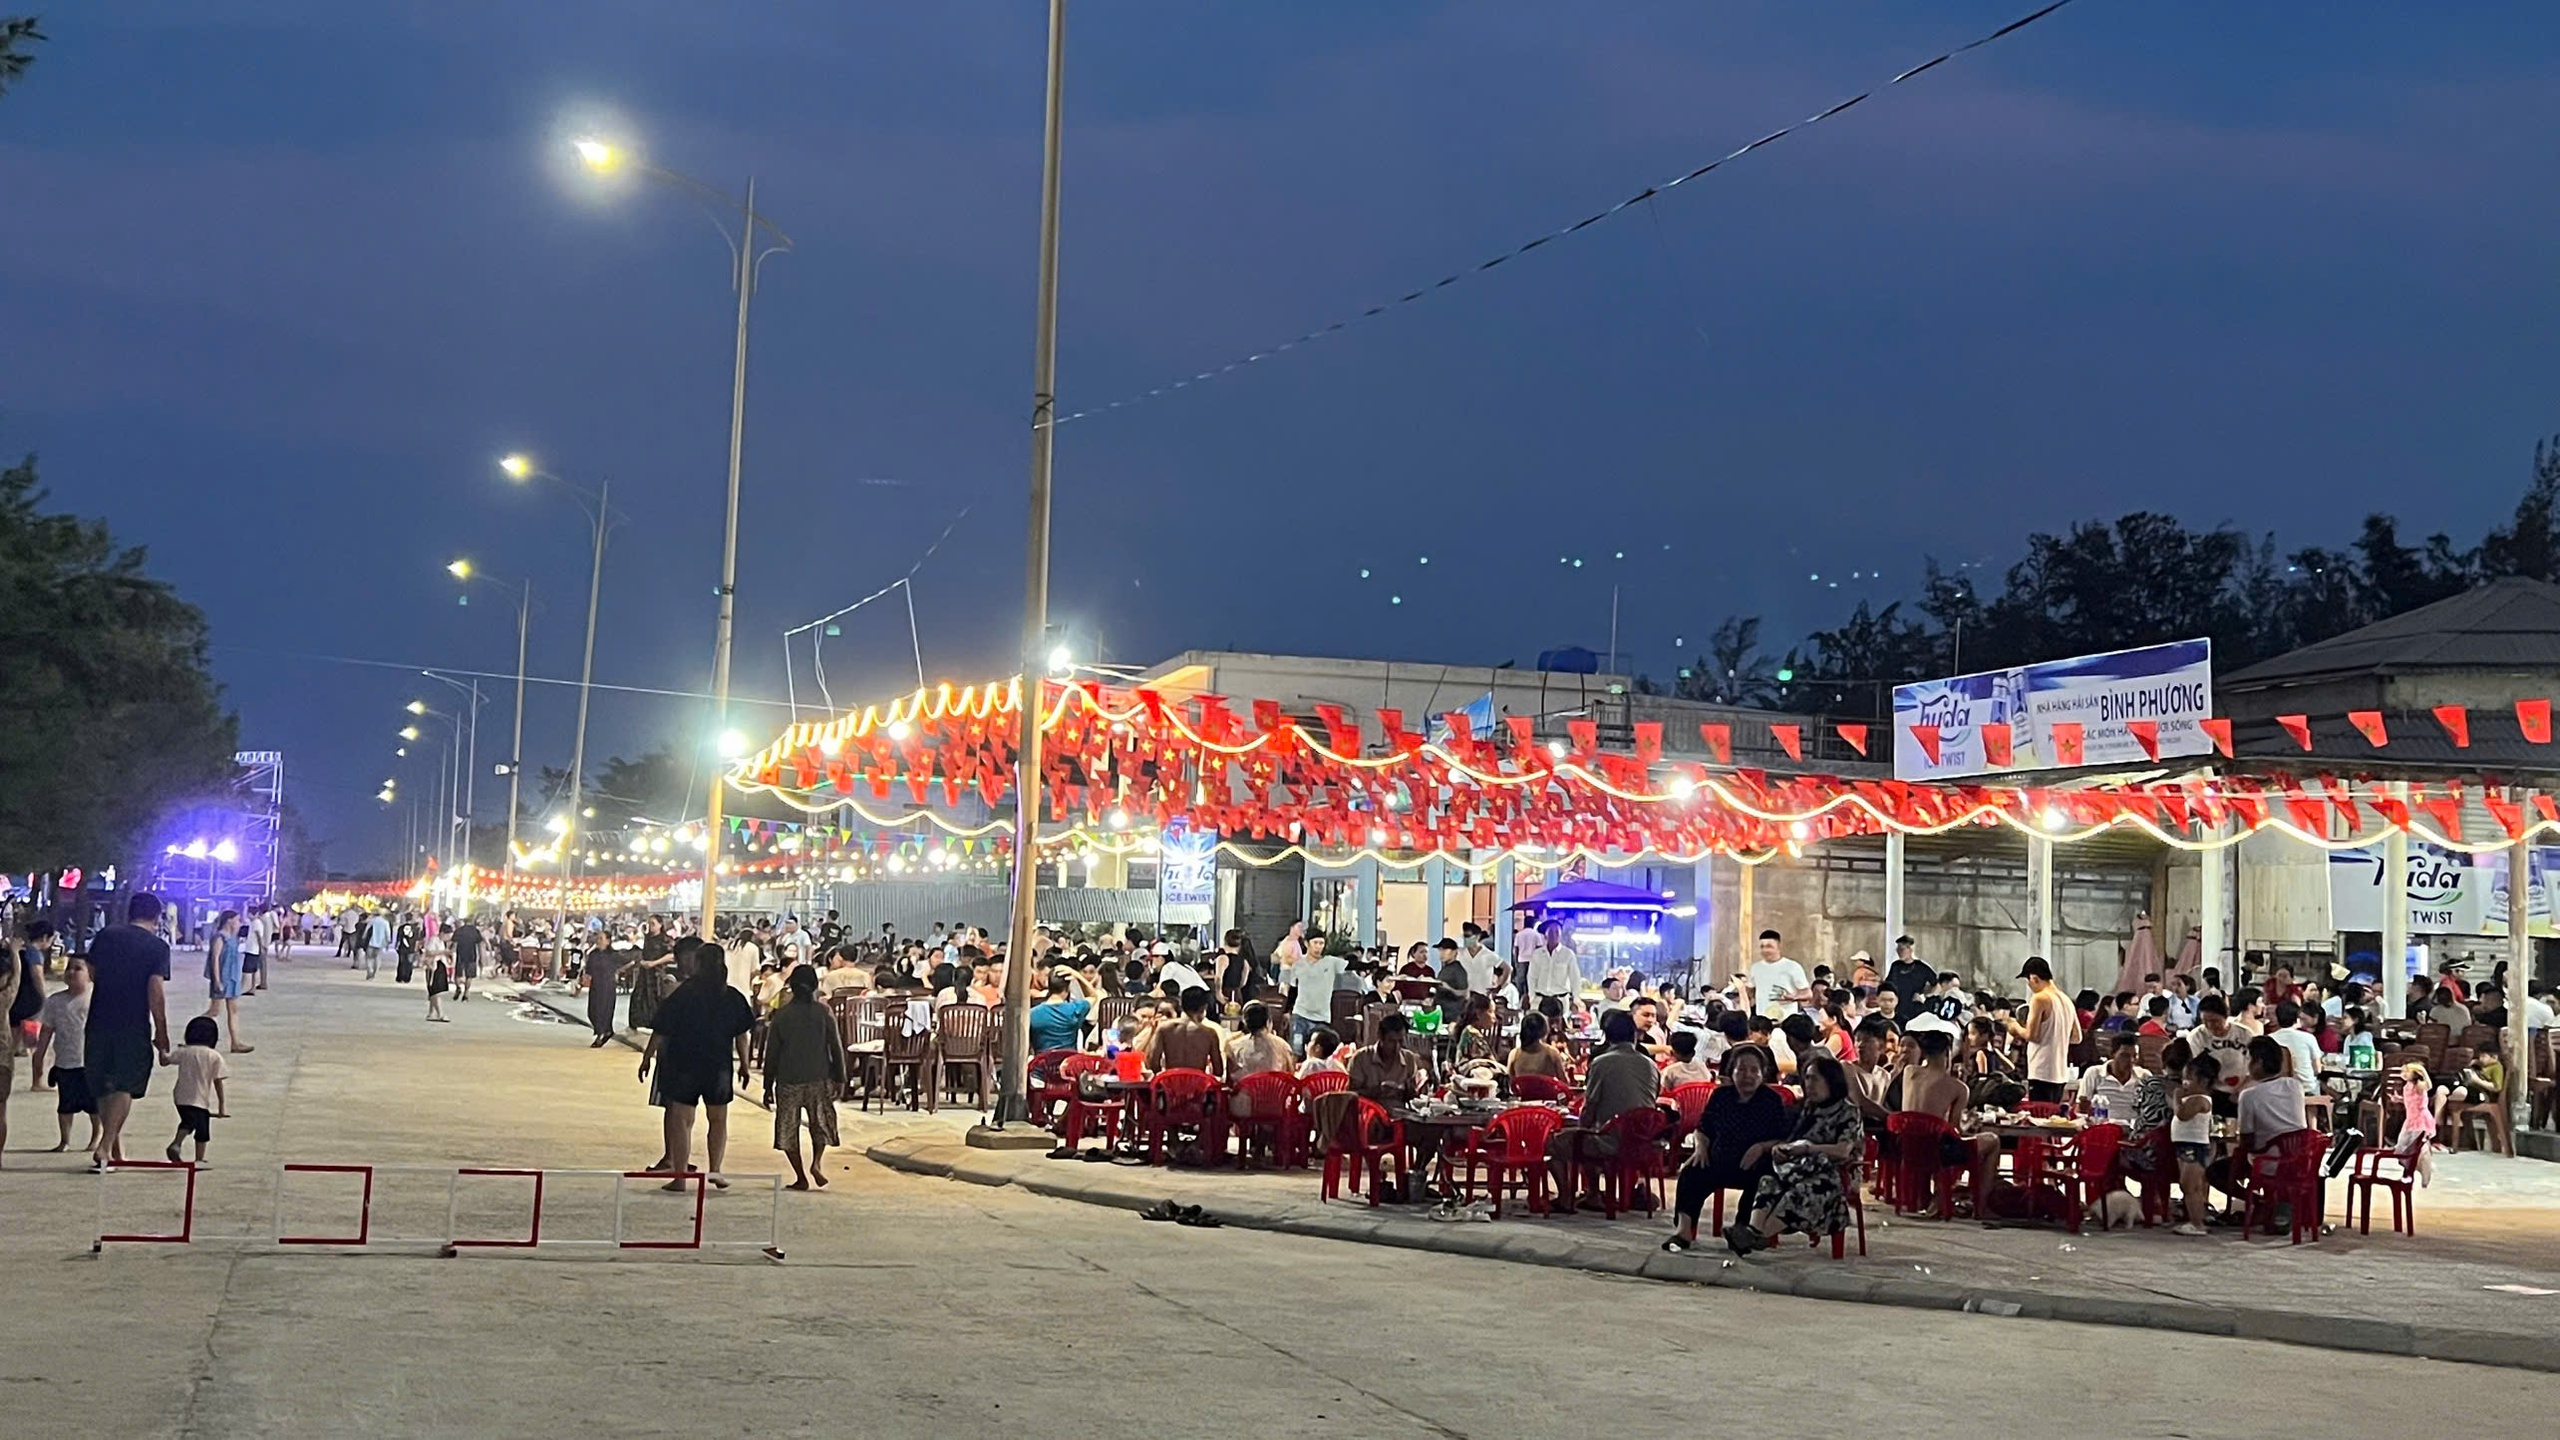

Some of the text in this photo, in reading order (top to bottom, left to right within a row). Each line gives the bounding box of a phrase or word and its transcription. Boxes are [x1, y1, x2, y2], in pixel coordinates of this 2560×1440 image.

[2101, 688, 2135, 721] BÌNH
[2139, 683, 2204, 717] PHƯƠNG
[1940, 750, 1965, 767] TWIST
[1165, 893, 1212, 902] ICE TWIST
[2412, 910, 2453, 924] TWIST
